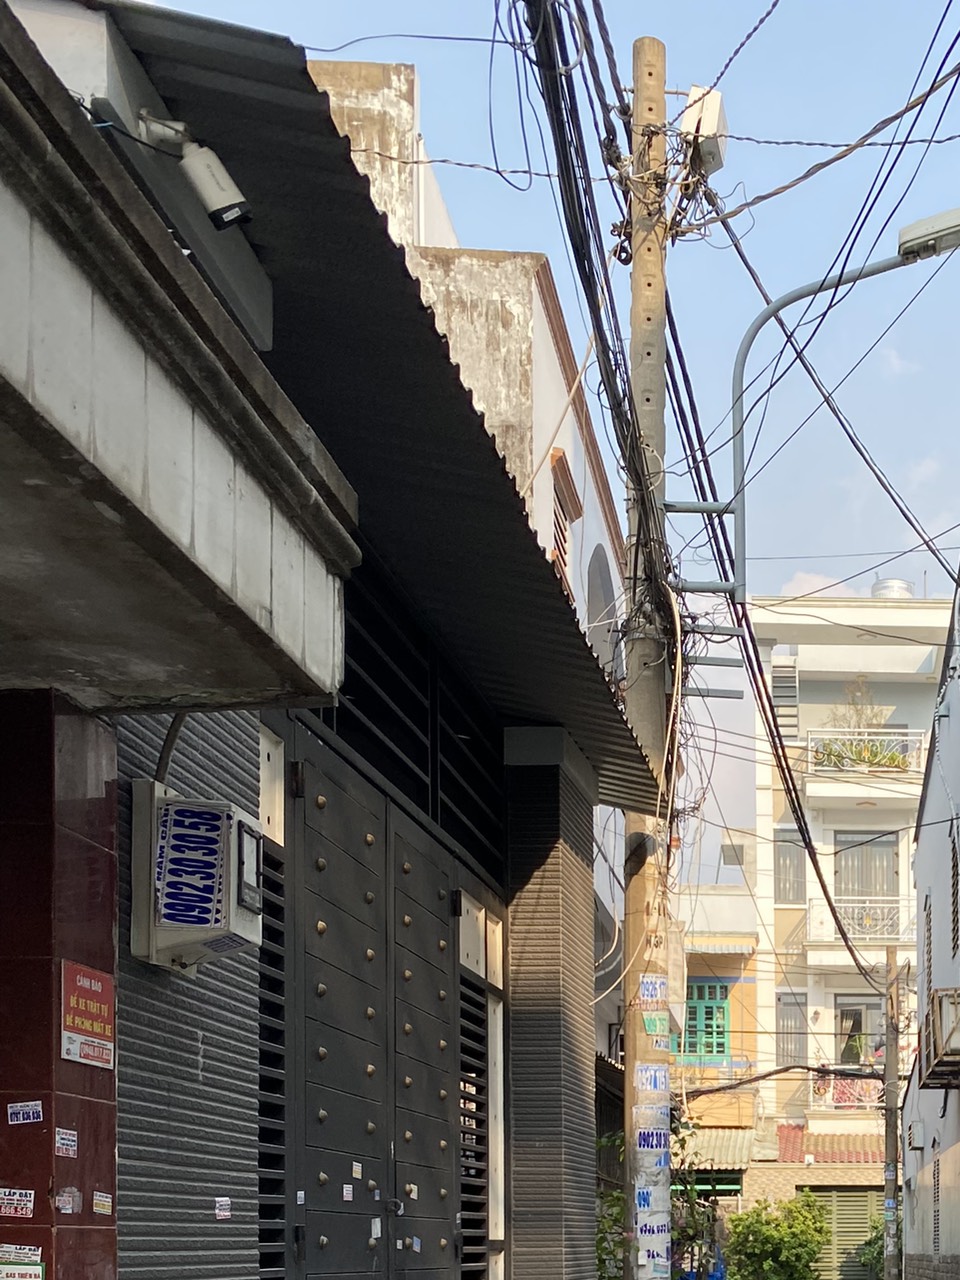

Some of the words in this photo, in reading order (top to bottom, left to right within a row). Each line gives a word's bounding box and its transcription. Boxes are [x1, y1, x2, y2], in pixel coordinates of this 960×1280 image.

[162, 808, 223, 925] 0902.30.30.58
[76, 972, 91, 988] CẢNH
[91, 978, 103, 993] BÁO
